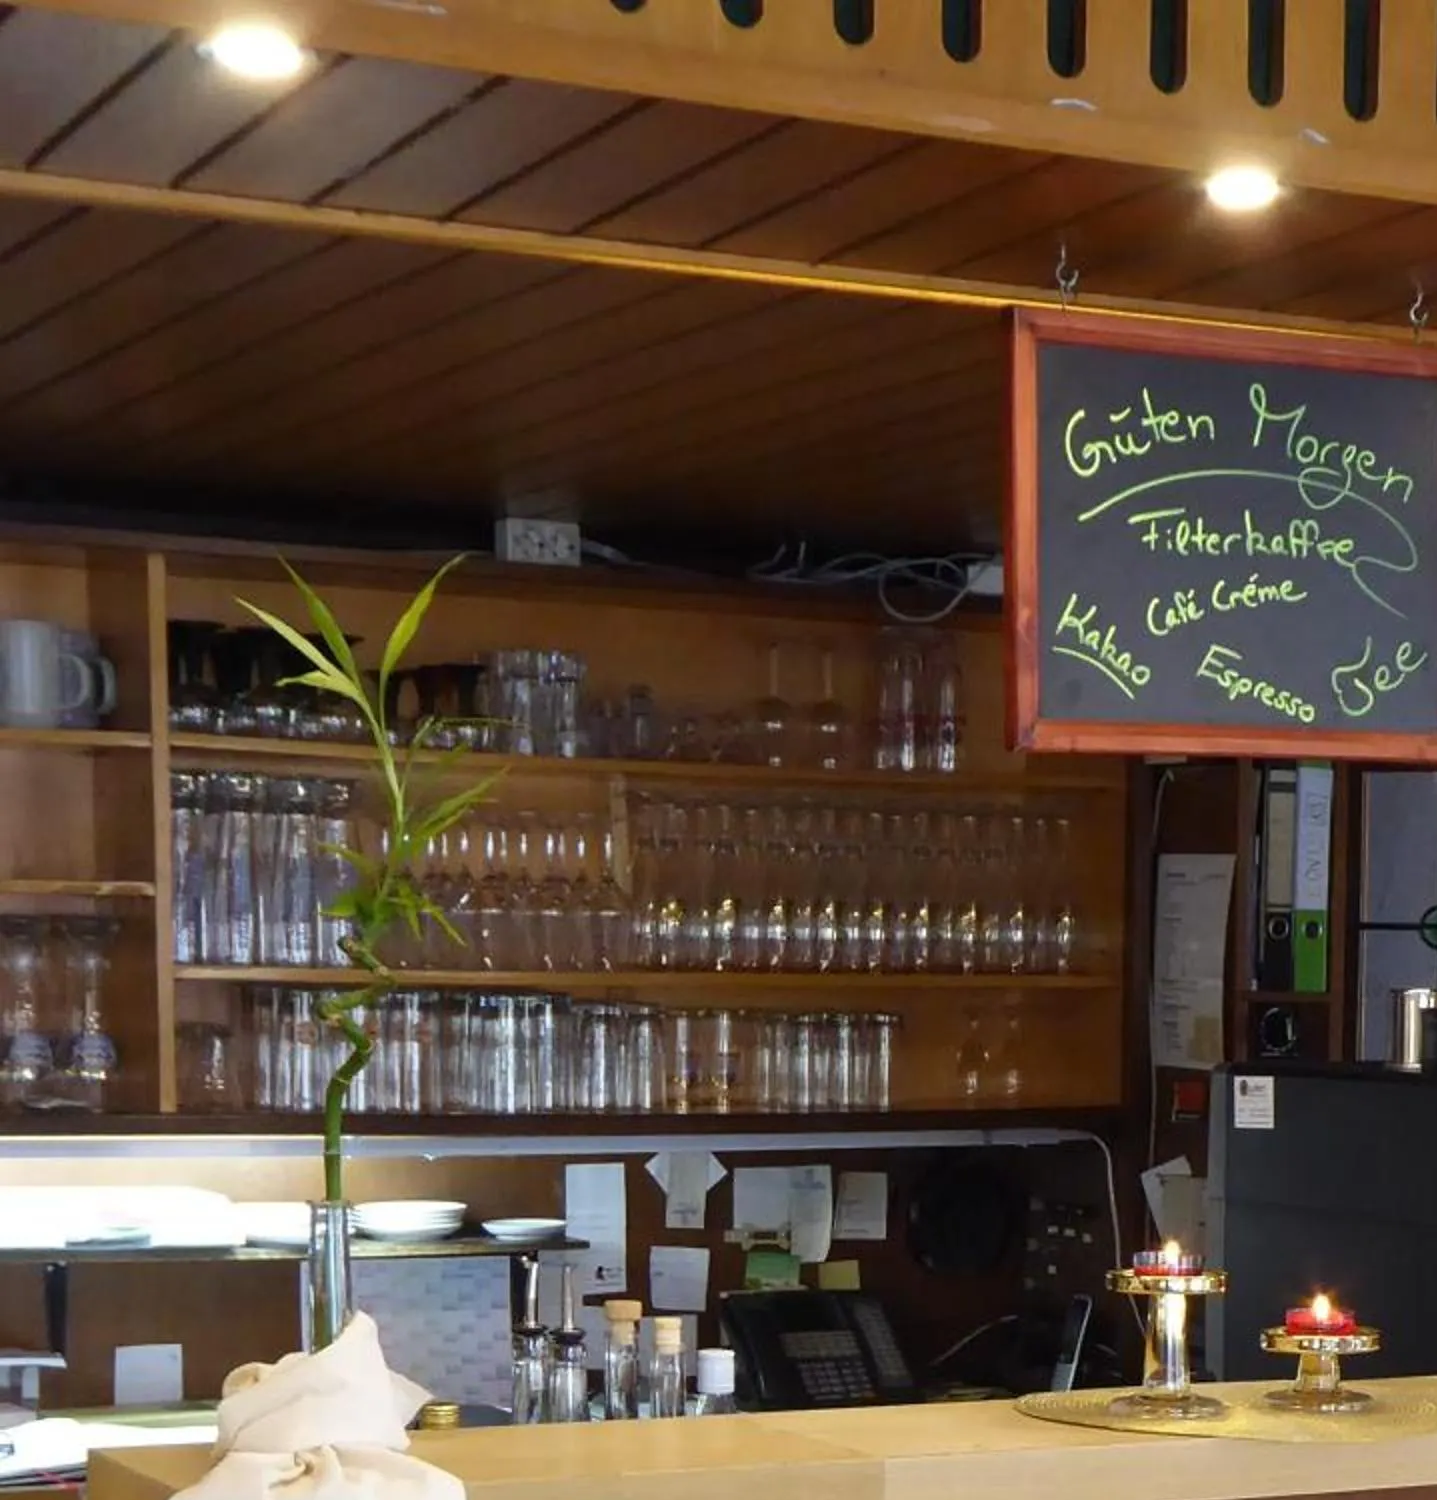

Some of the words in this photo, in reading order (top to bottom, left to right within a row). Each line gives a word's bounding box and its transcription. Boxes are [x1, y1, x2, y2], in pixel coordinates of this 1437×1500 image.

[1249, 383, 1414, 510] Morgen
[1128, 507, 1355, 568] Filterkaffee
[1055, 593, 1150, 686] Kakao
[1147, 588, 1204, 636] Café
[1196, 643, 1316, 723] Espresso
[1331, 635, 1428, 717] Tee
